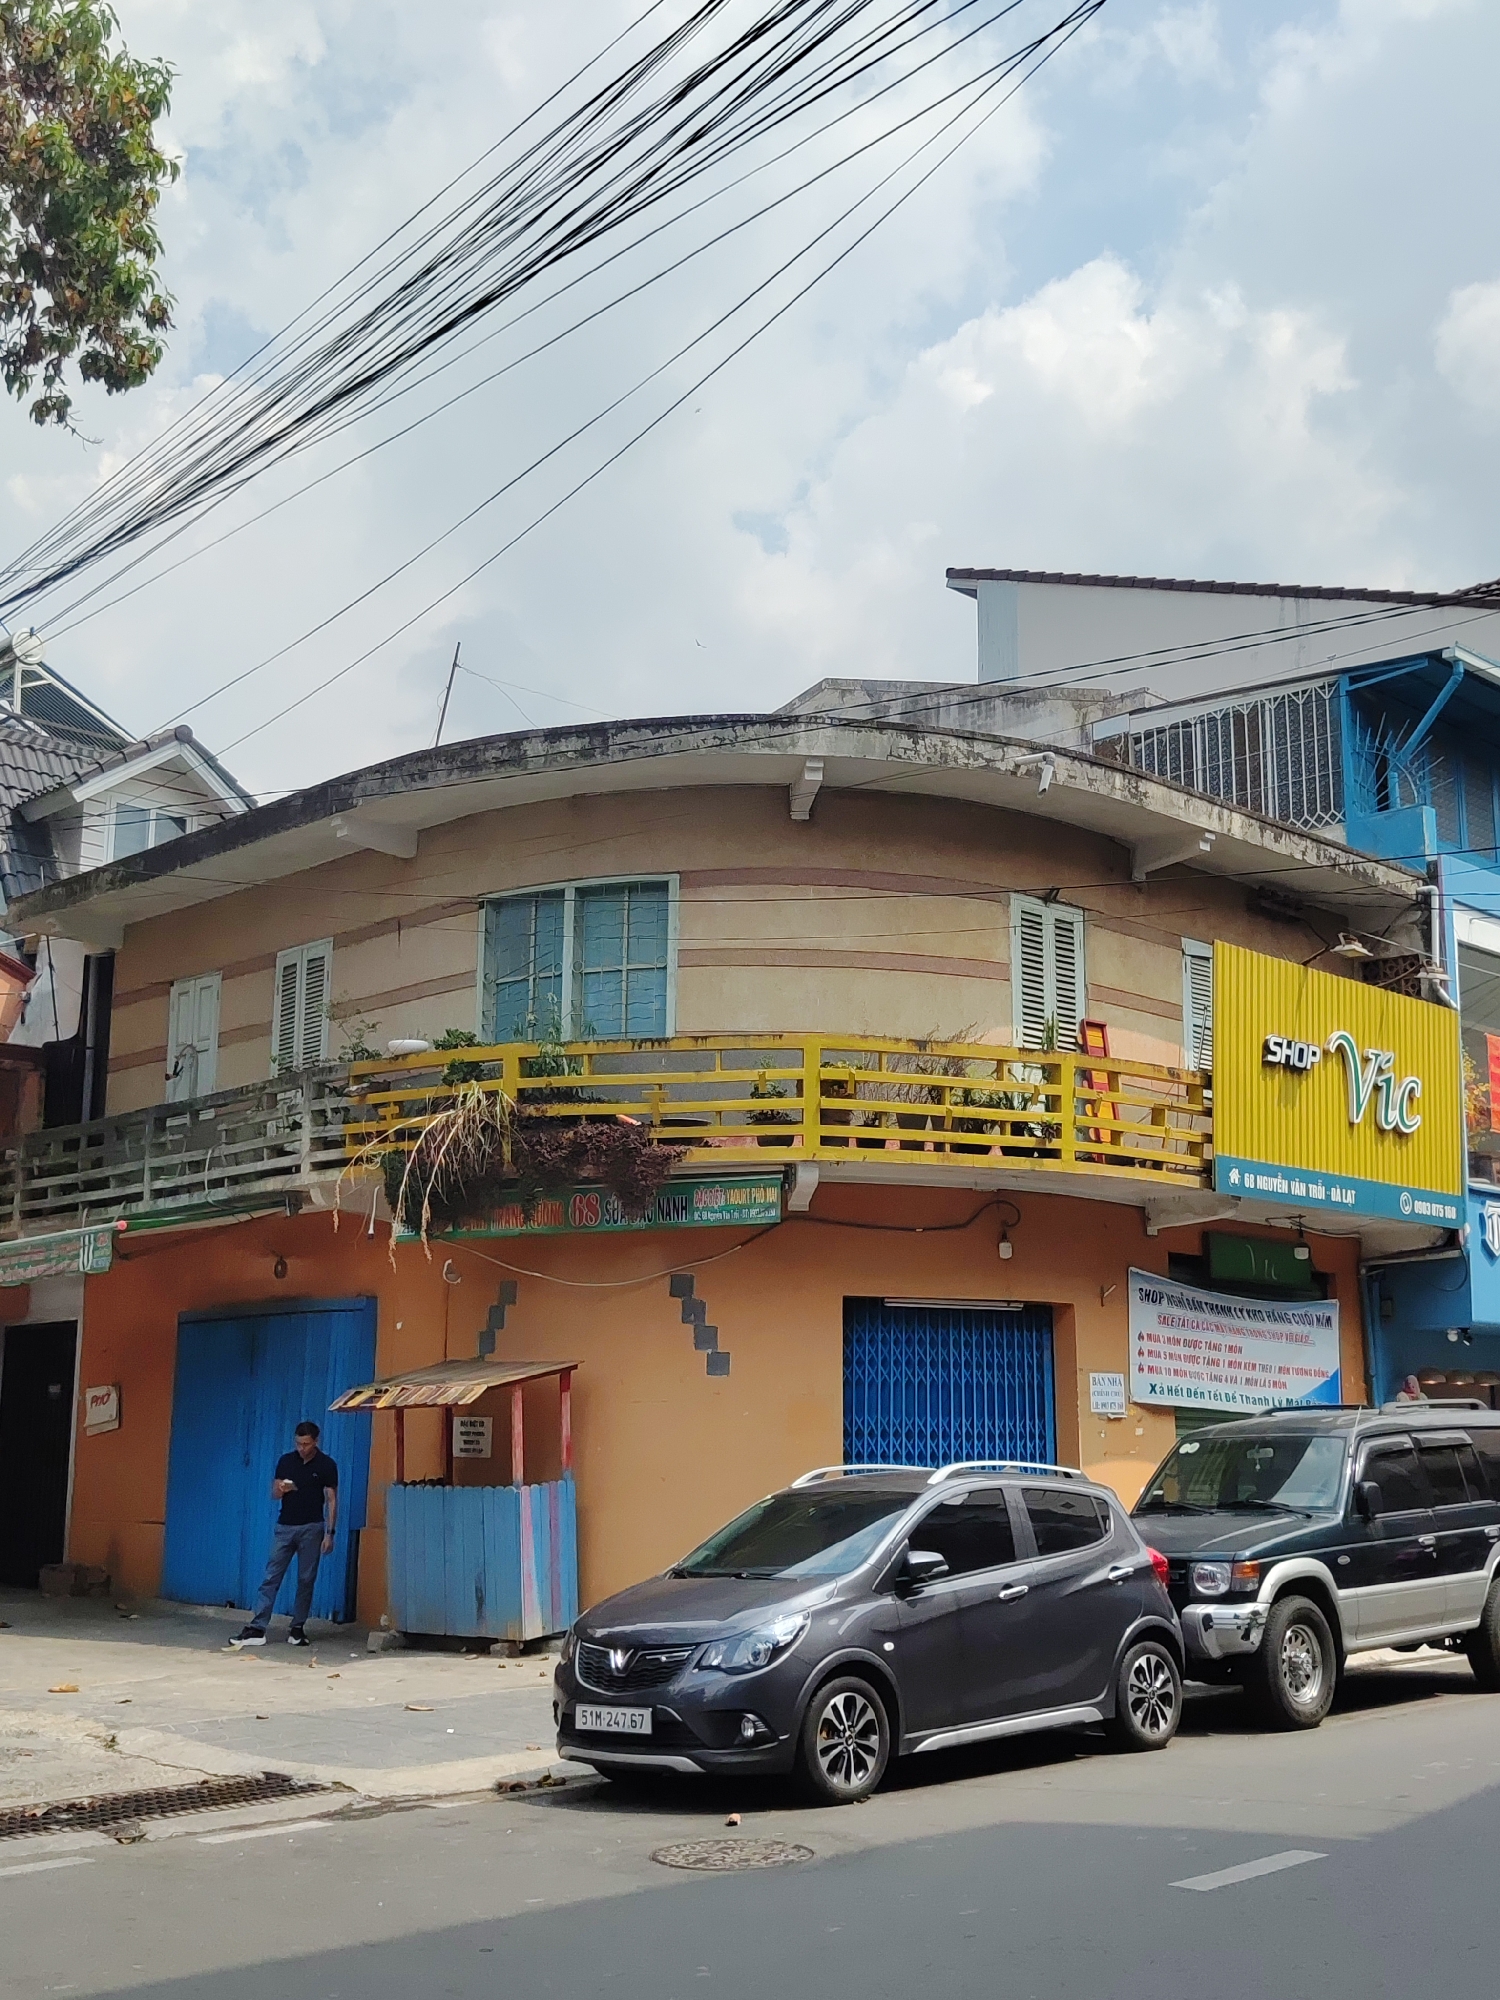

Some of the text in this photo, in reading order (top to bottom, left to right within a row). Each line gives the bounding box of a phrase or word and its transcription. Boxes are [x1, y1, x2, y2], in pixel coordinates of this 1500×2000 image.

[1265, 1034, 1321, 1070] SHOP
[726, 1187, 751, 1205] YAOURT
[1256, 1172, 1288, 1194] NGUYỄN
[1290, 1178, 1306, 1197] VĂN
[1308, 1179, 1325, 1200] TRỖI
[1342, 1188, 1356, 1208] LẠT
[569, 1192, 602, 1227] 68
[1138, 1287, 1164, 1305] SHOP
[1204, 1301, 1235, 1320] THANH
[1246, 1307, 1265, 1322] KHO
[1292, 1310, 1314, 1327] CUỐI
[1158, 1314, 1175, 1327] SALE
[1267, 1330, 1284, 1341] SHOP
[1146, 1332, 1161, 1344] MUA
[1166, 1334, 1181, 1347] MÓN
[1182, 1338, 1202, 1351] ĐƯỢC
[1204, 1340, 1222, 1353] TẶNG
[1228, 1343, 1243, 1355] MÓN
[1147, 1348, 1162, 1360] MUA
[1182, 1353, 1201, 1367] ĐƯỢC
[1202, 1355, 1220, 1368] TẶNG
[1227, 1359, 1242, 1370] MÓN
[1258, 1363, 1273, 1374] THEO
[1147, 1365, 1163, 1376] MUA
[1164, 1367, 1172, 1377] 10
[1173, 1366, 1188, 1378] MÓN
[1206, 1371, 1224, 1385] TẶNG
[1229, 1373, 1238, 1385] VÀ
[1244, 1375, 1260, 1387] MÓN
[1272, 1379, 1288, 1390] MÓN
[1149, 1382, 1165, 1396] Xả
[1167, 1384, 1184, 1398] Hết
[1207, 1388, 1223, 1402] Tết
[1239, 1393, 1270, 1407] Thanh
